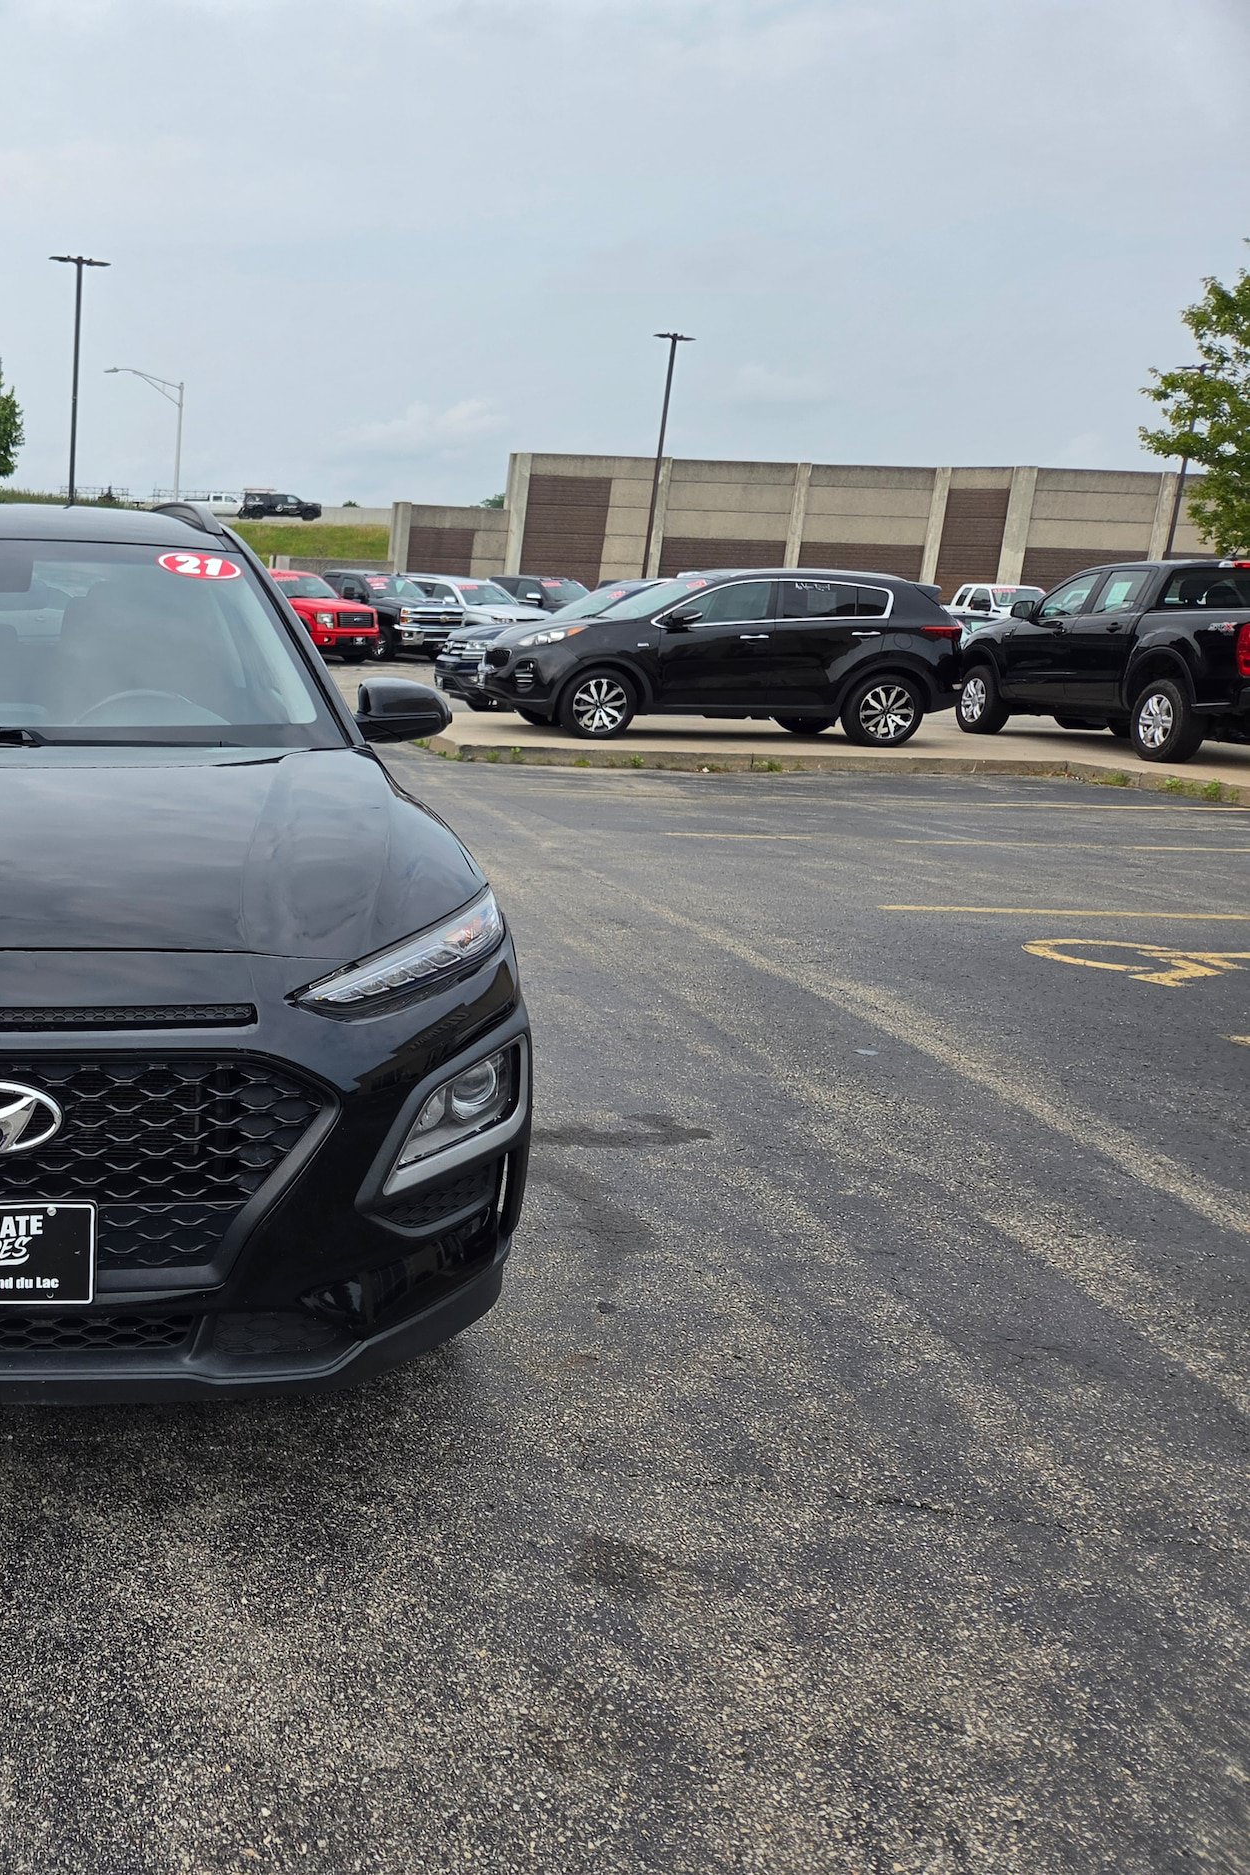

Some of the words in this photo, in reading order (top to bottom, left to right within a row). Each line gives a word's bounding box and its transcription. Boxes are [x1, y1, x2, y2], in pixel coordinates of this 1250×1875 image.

[175, 556, 223, 576] 21
[16, 1276, 33, 1289] du
[36, 1276, 59, 1289] Lac
